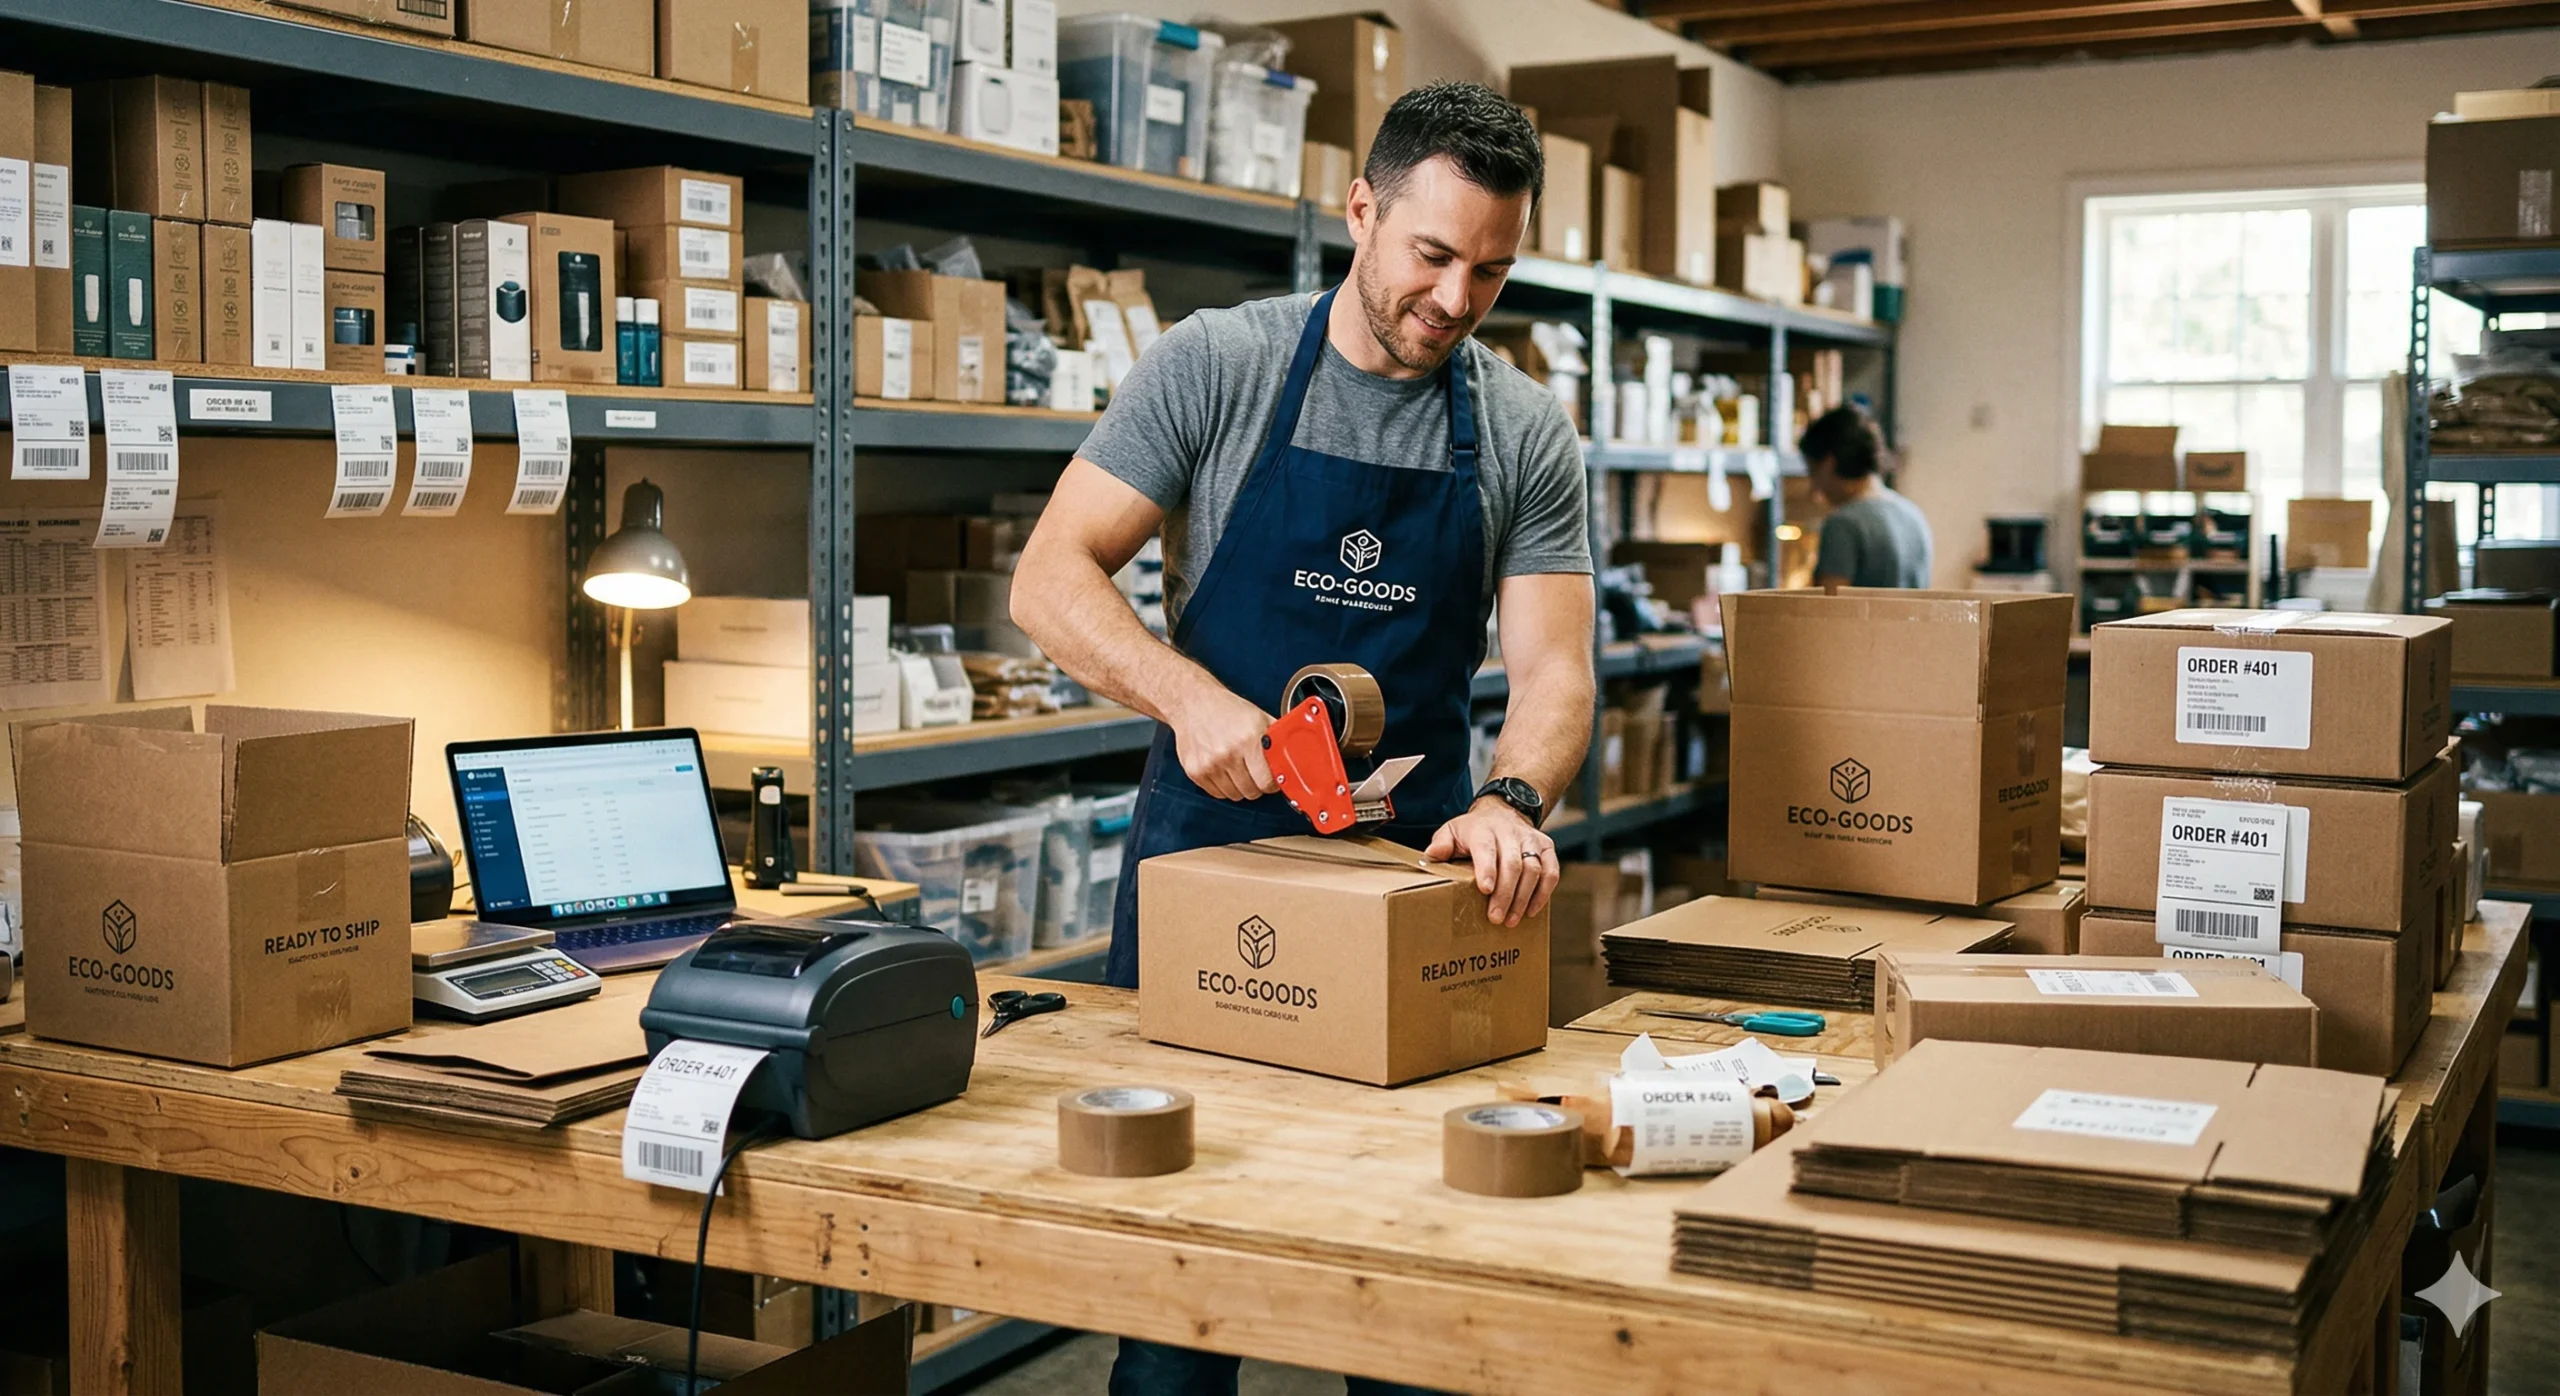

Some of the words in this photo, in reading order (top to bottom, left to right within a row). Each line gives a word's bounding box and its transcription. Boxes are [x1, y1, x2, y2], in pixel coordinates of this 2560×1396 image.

[1294, 569, 1416, 602] ECO-GOODS
[2187, 658, 2239, 674] ORDER
[2243, 660, 2278, 676] #401
[1788, 805, 1913, 834] ECO-GOODS
[2172, 824, 2226, 844] ORDER
[2231, 830, 2268, 848] #401
[264, 930, 317, 955] READY
[320, 926, 342, 944] TO
[345, 920, 380, 940] SHIP
[68, 956, 174, 990] ECO-GOODS
[1422, 957, 1467, 982] READY
[1469, 955, 1487, 973] TO
[1490, 948, 1520, 968] SHIP
[1198, 969, 1318, 1009] ECO-GOODS
[658, 1057, 704, 1075] ORDER
[703, 1064, 738, 1080] #401
[1643, 1091, 1695, 1104] ORDER
